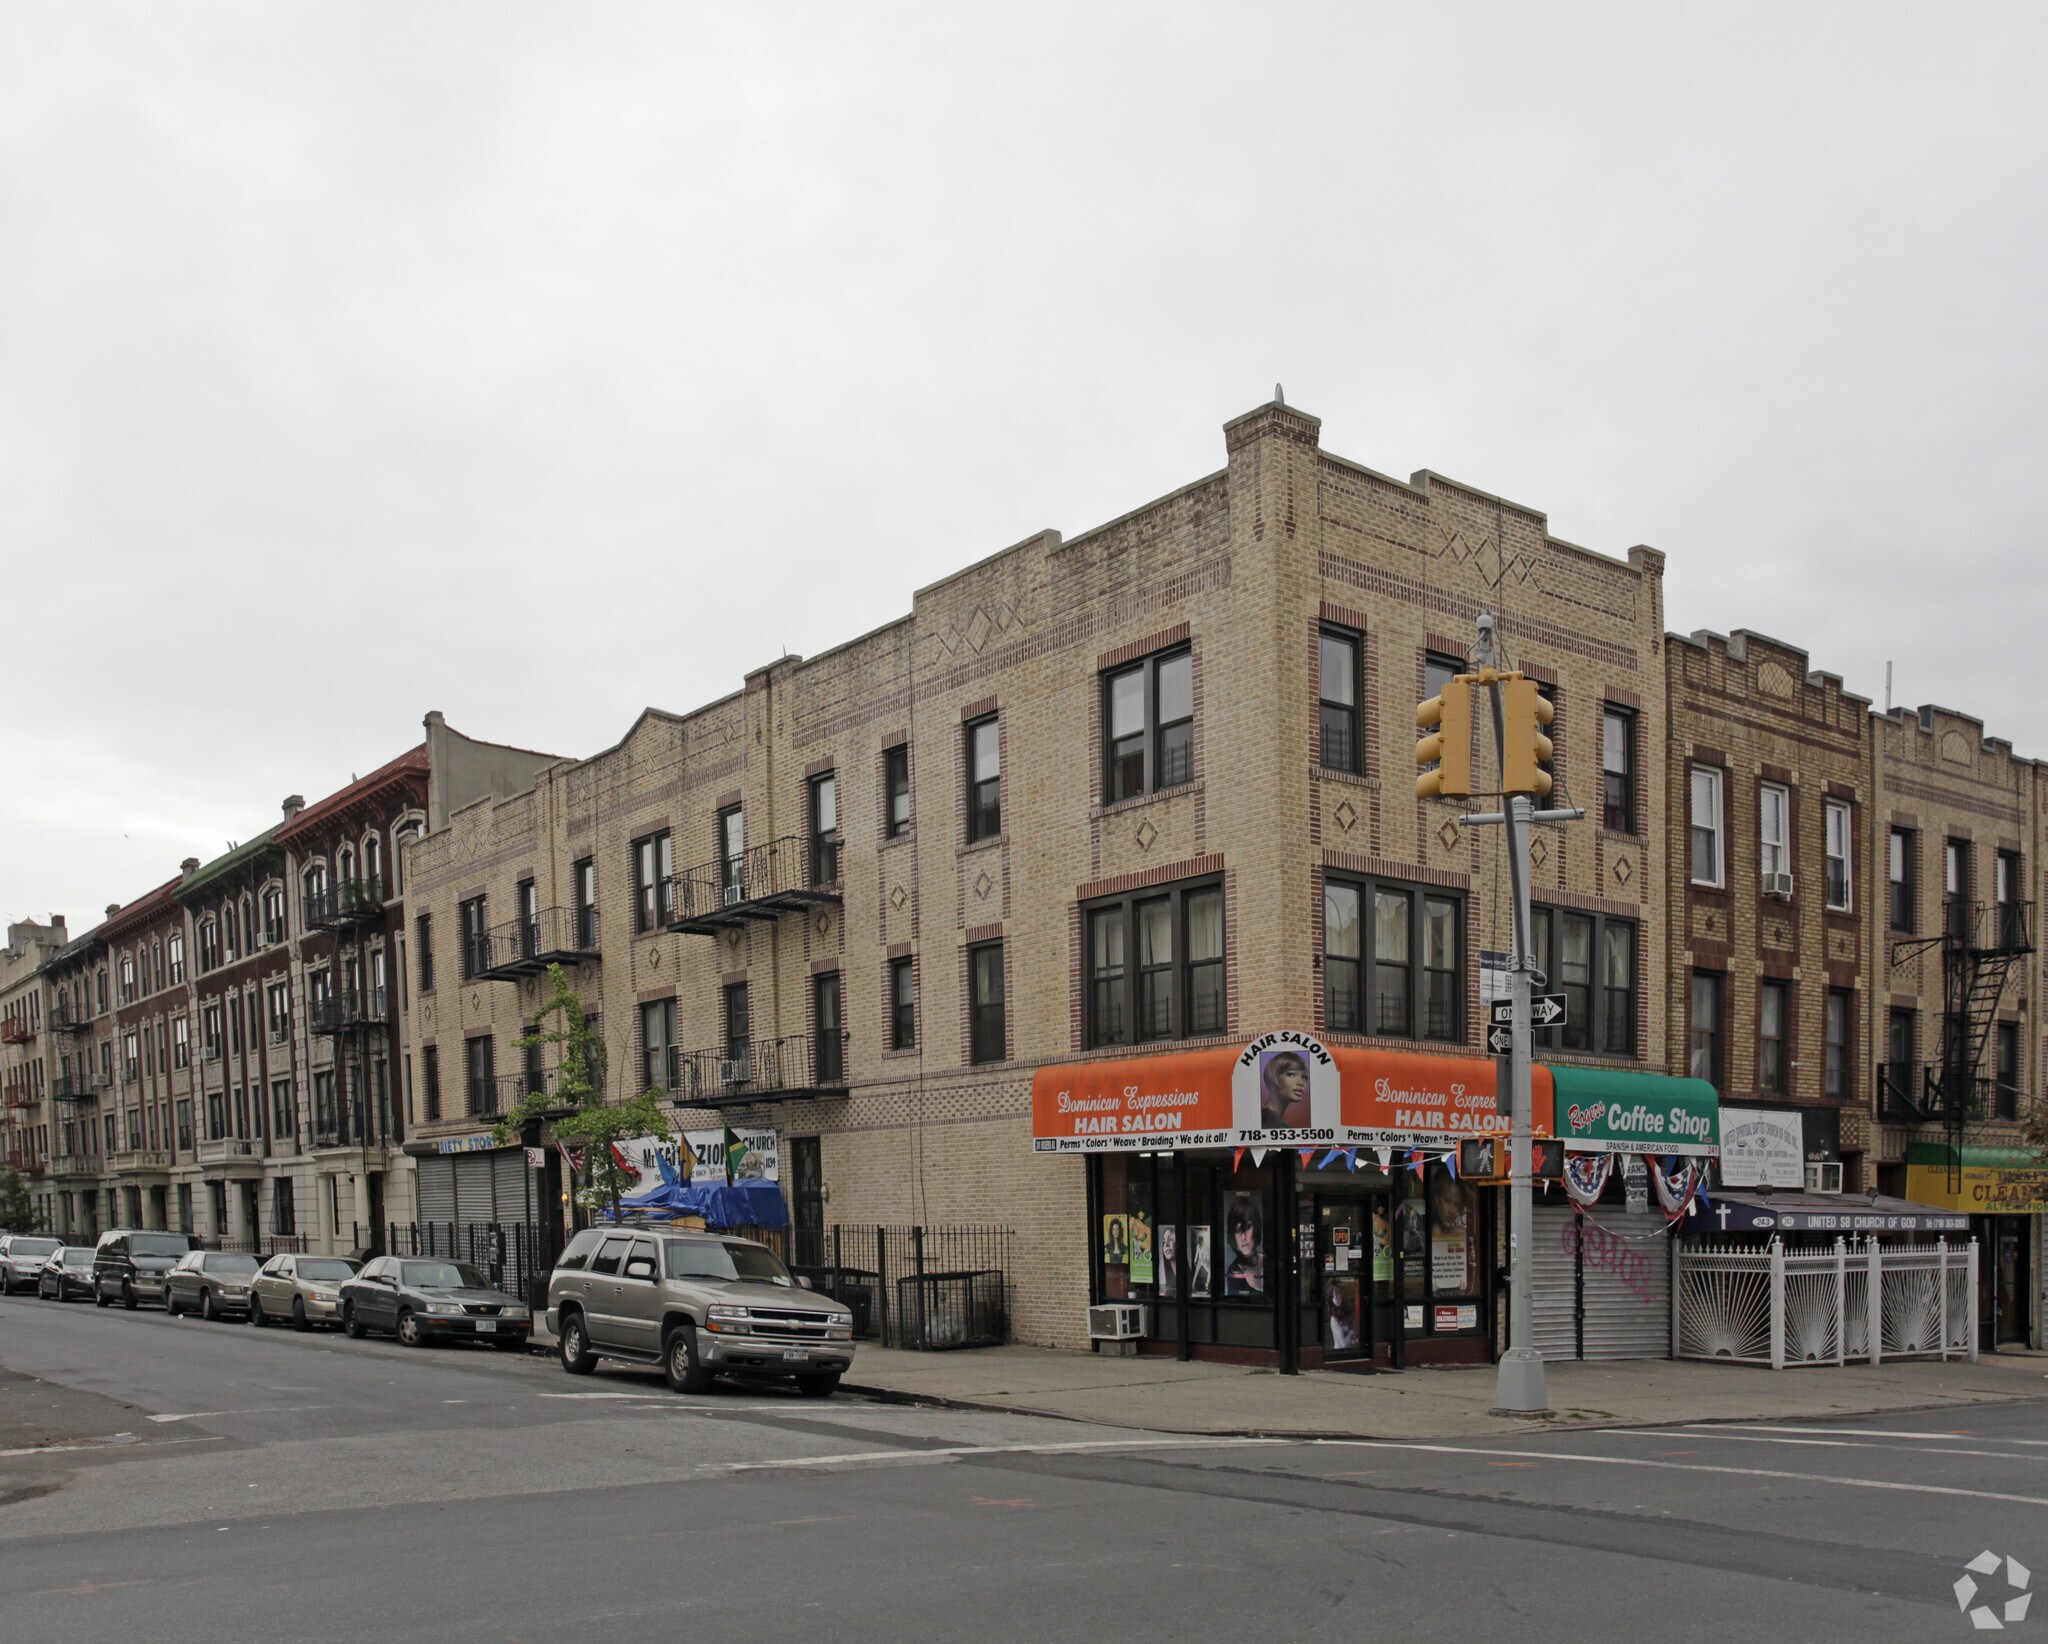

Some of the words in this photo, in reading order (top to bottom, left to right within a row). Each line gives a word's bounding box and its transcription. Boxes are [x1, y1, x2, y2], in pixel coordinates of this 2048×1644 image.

[1501, 1007, 1512, 1019] ON
[1532, 1005, 1555, 1017] WAY
[1495, 1034, 1508, 1047] ONE
[1240, 1034, 1277, 1067] HAIR
[1280, 1031, 1331, 1066] SALON
[1057, 1090, 1121, 1114] Dominican
[1123, 1086, 1199, 1116] Expressions
[1375, 1077, 1448, 1107] Dominican
[1450, 1083, 1497, 1115] Expres
[1074, 1116, 1118, 1134] HAIR
[1122, 1111, 1183, 1132] SALON
[1395, 1109, 1445, 1128] HAIR
[1449, 1112, 1509, 1131] SALON
[1607, 1103, 1665, 1133] Coffee
[1668, 1107, 1710, 1142] Shop
[1060, 1139, 1081, 1149] Perms
[1086, 1138, 1108, 1148] Colors
[1113, 1137, 1136, 1147] Weave
[1141, 1136, 1174, 1148] Braiding
[1180, 1134, 1192, 1144] We
[1193, 1133, 1204, 1144] do
[1205, 1132, 1212, 1143] it
[1213, 1132, 1228, 1143] all!
[1269, 1128, 1334, 1141] 953-5500
[1347, 1129, 1374, 1141] Perms
[1380, 1131, 1406, 1142] Colors
[1413, 1132, 1438, 1143] Weave
[468, 1136, 493, 1151] STOR
[1606, 1142, 1629, 1151] SPANISH
[1630, 1142, 1635, 1151] &
[1636, 1143, 1663, 1152] AMERICAN
[1664, 1144, 1679, 1153] FOOD
[696, 1143, 724, 1165] ZIO
[1756, 1218, 1770, 1226] 243
[1807, 1216, 1837, 1228] UNITED
[1840, 1216, 1851, 1228] SB
[1854, 1216, 1884, 1229] CHURCH
[1888, 1217, 1898, 1229] OF
[1901, 1217, 1917, 1229] GOD
